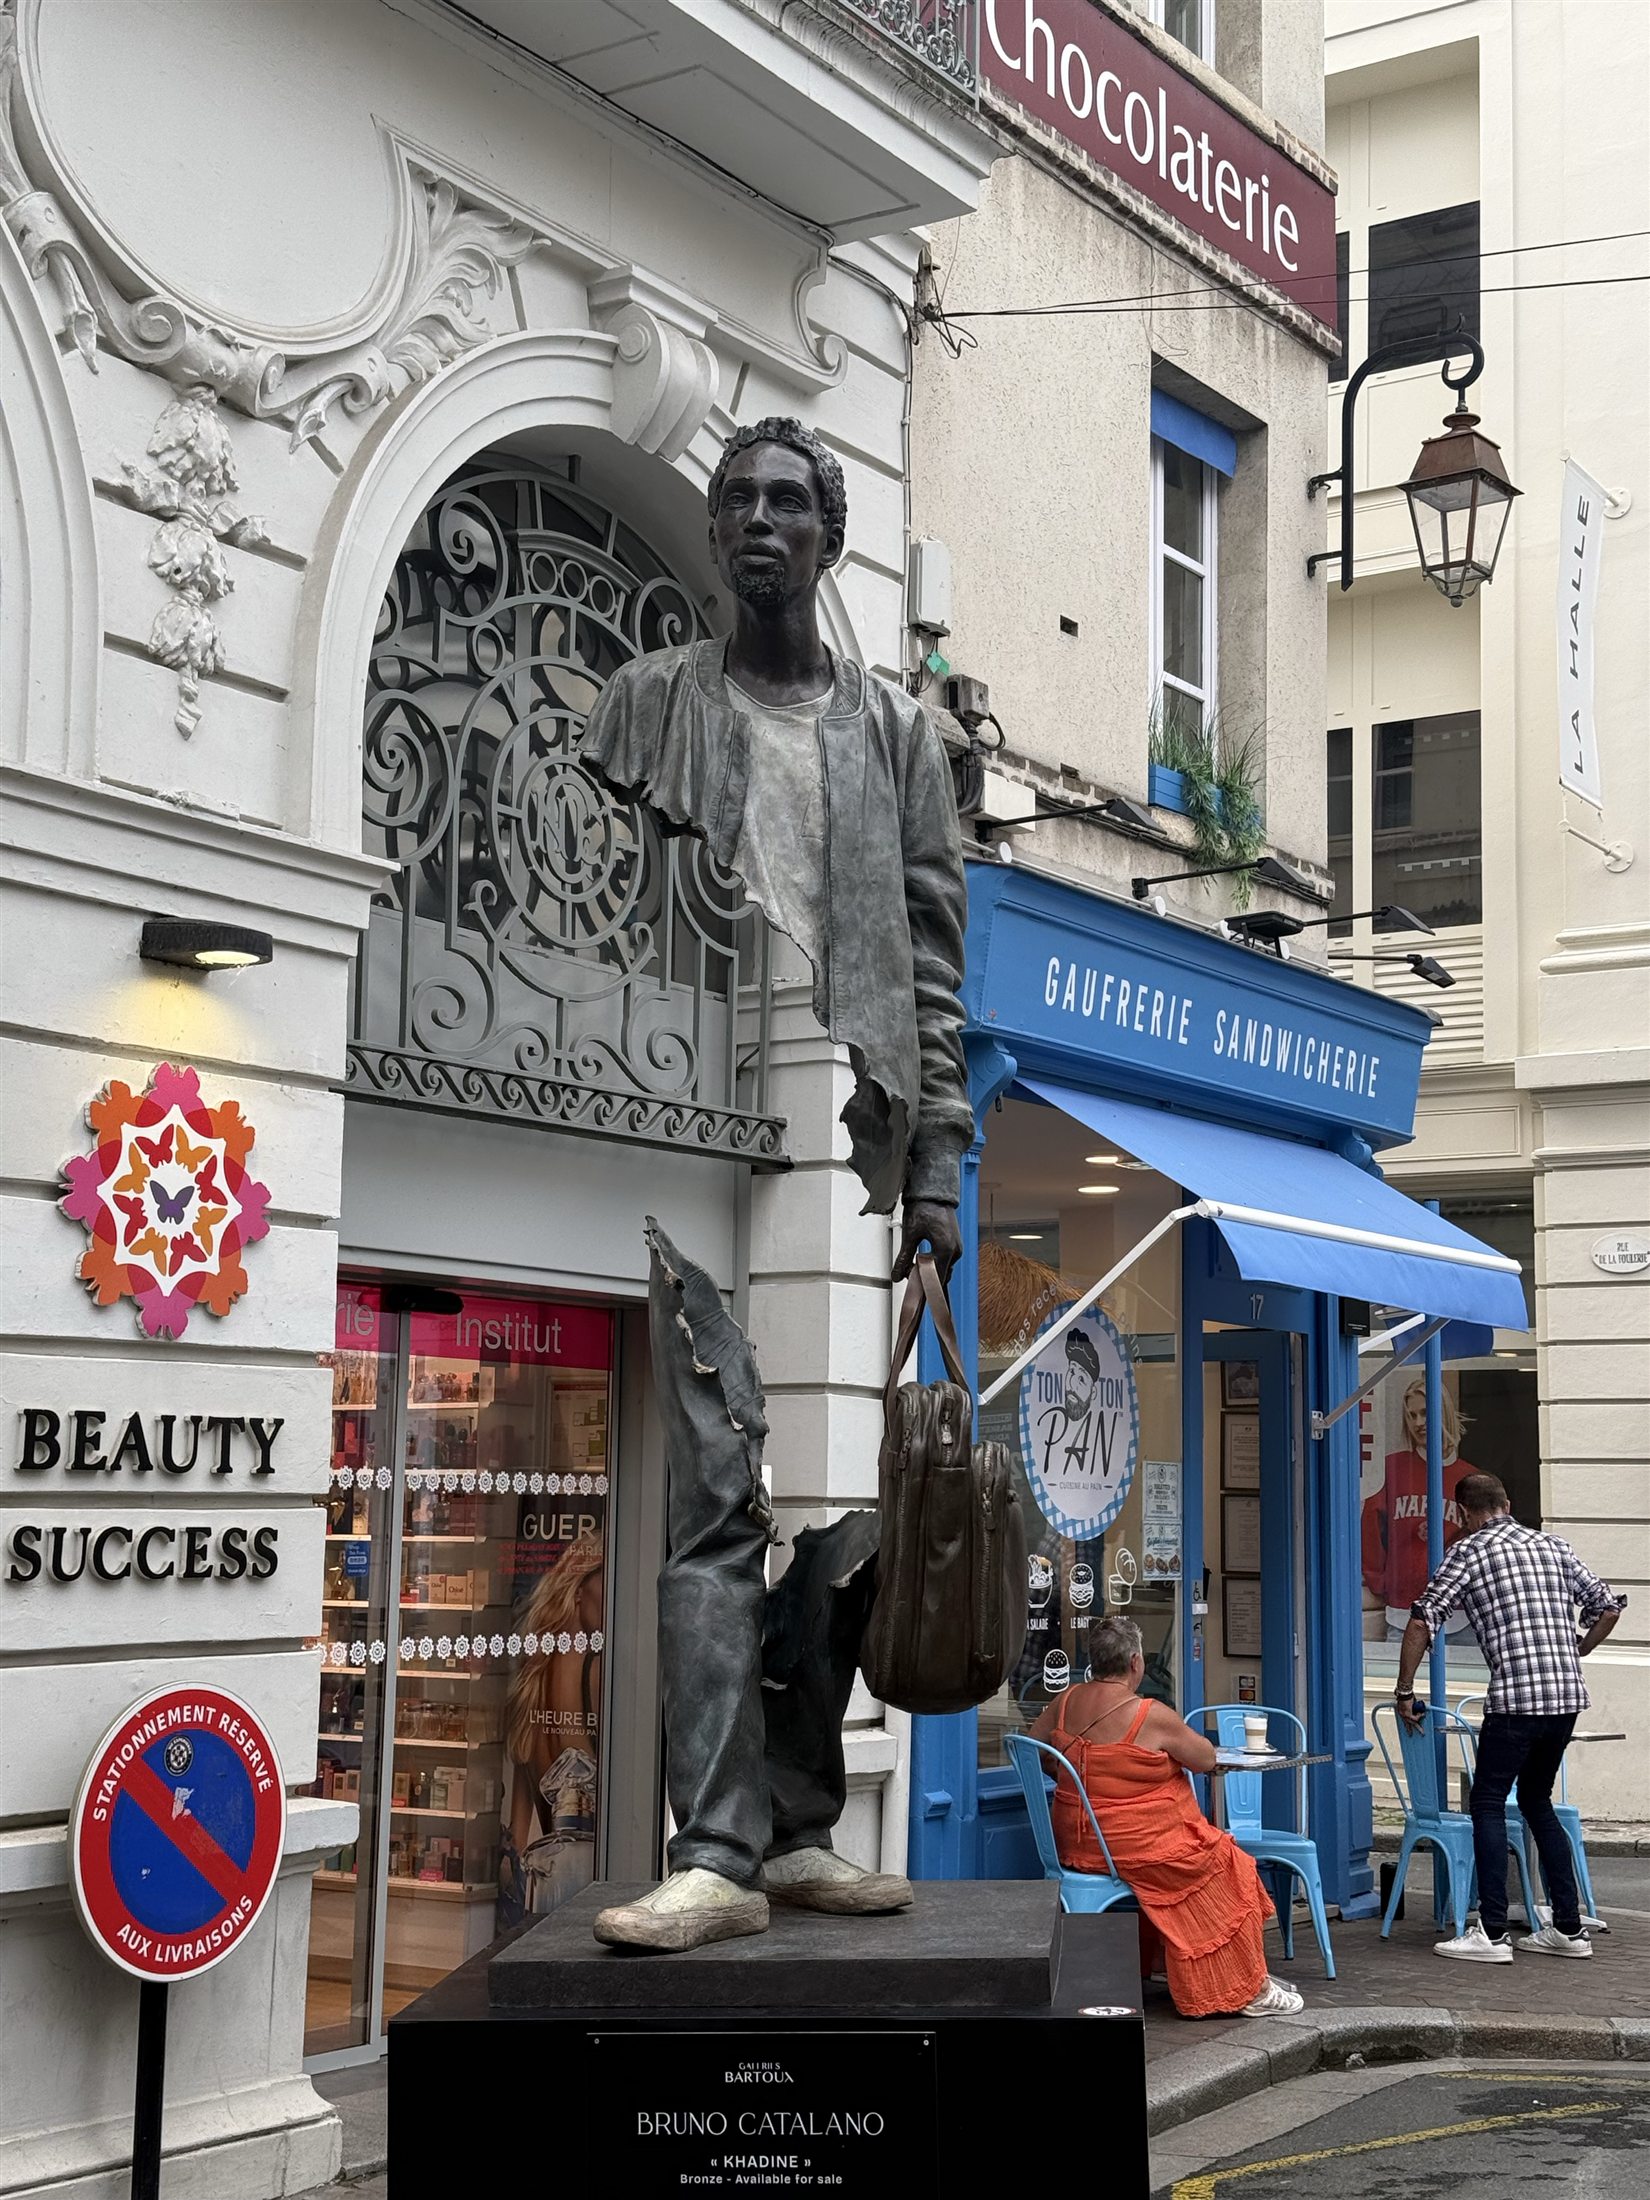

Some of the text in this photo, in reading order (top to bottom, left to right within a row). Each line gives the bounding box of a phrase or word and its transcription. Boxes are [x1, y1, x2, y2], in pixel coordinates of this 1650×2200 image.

[984, 0, 1300, 272] Chocolaterie
[1569, 495, 1590, 774] LA HALLE
[1044, 956, 1380, 1098] GAUFRERIE SANDWICHERIE
[1250, 1293, 1265, 1321] 17
[455, 1312, 562, 1354] Institut
[1037, 1371, 1124, 1409] TON TON
[15, 1408, 285, 1475] BEAUTY
[1037, 1406, 1118, 1477] PAN
[7, 1525, 279, 1582] SUCCESS
[529, 1709, 583, 1726] L'HEURE
[551, 1727, 585, 1736] NOUVEAU
[92, 1704, 274, 1822] STATIONNEMENT RÉSERVÉ
[116, 1894, 254, 1964] AUX LIVRAISONS
[724, 2071, 795, 2084] BARTOUX
[637, 2111, 885, 2136] BRUNO CATALANO
[680, 2174, 723, 2184] Bronze
[735, 2174, 791, 2184] Available
[795, 2174, 813, 2184] for
[817, 2174, 843, 2184] sale
[723, 2155, 799, 2168] KHADINE
